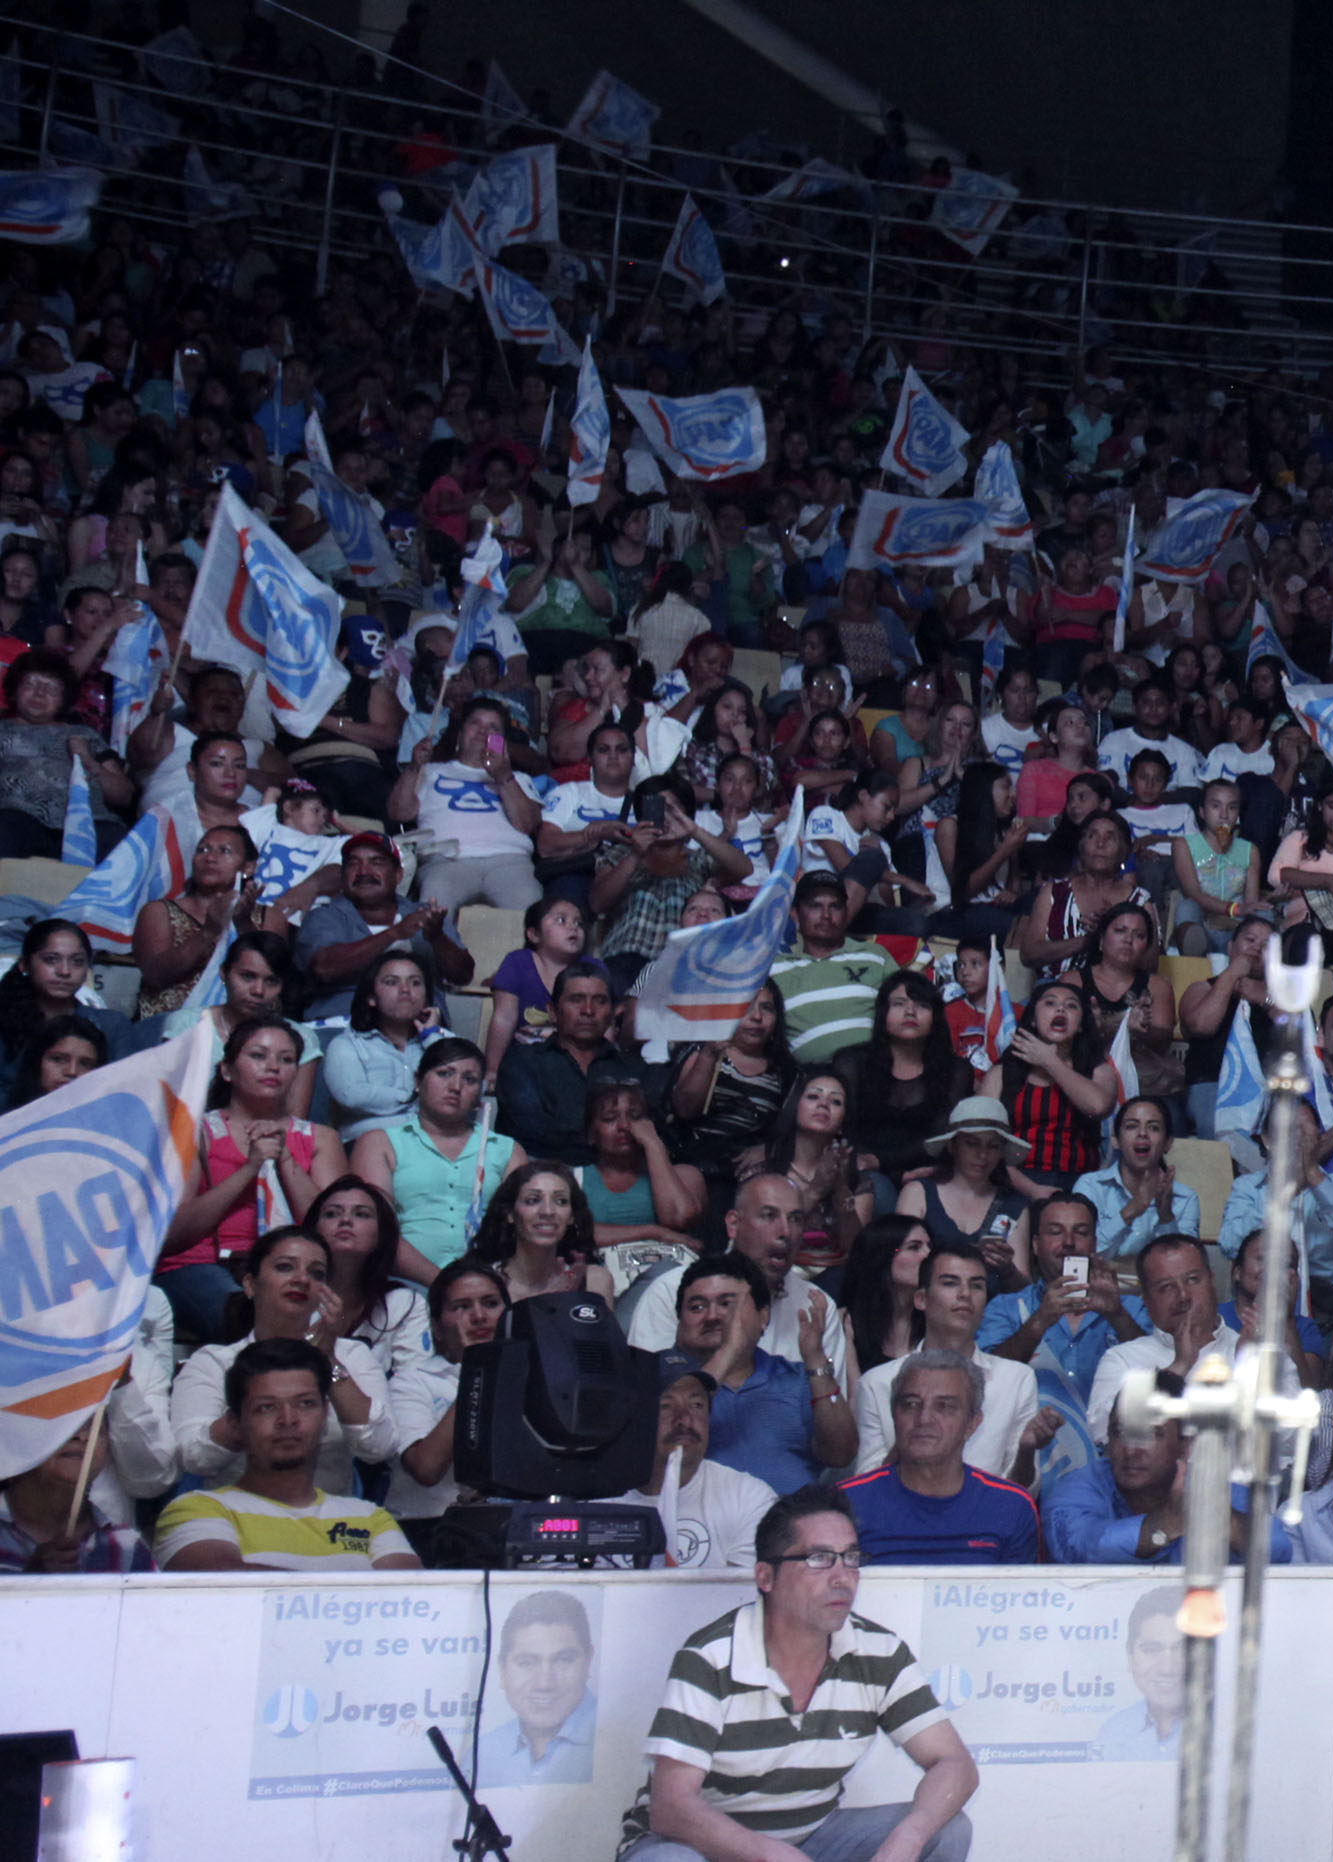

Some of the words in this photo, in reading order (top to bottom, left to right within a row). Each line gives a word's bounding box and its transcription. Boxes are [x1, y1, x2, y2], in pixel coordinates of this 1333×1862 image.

[275, 1593, 441, 1625] ¡Alégrate,
[933, 1584, 1075, 1614] ¡Alégrate,
[976, 1625, 1009, 1648] ya
[1019, 1624, 1049, 1641] se
[1059, 1618, 1119, 1641] van!
[324, 1639, 363, 1664] ya
[375, 1637, 410, 1656] se
[976, 1671, 1057, 1704] Jorge
[1062, 1670, 1116, 1698] Luis
[323, 1691, 418, 1727] Jorge
[424, 1689, 482, 1719] Luis
